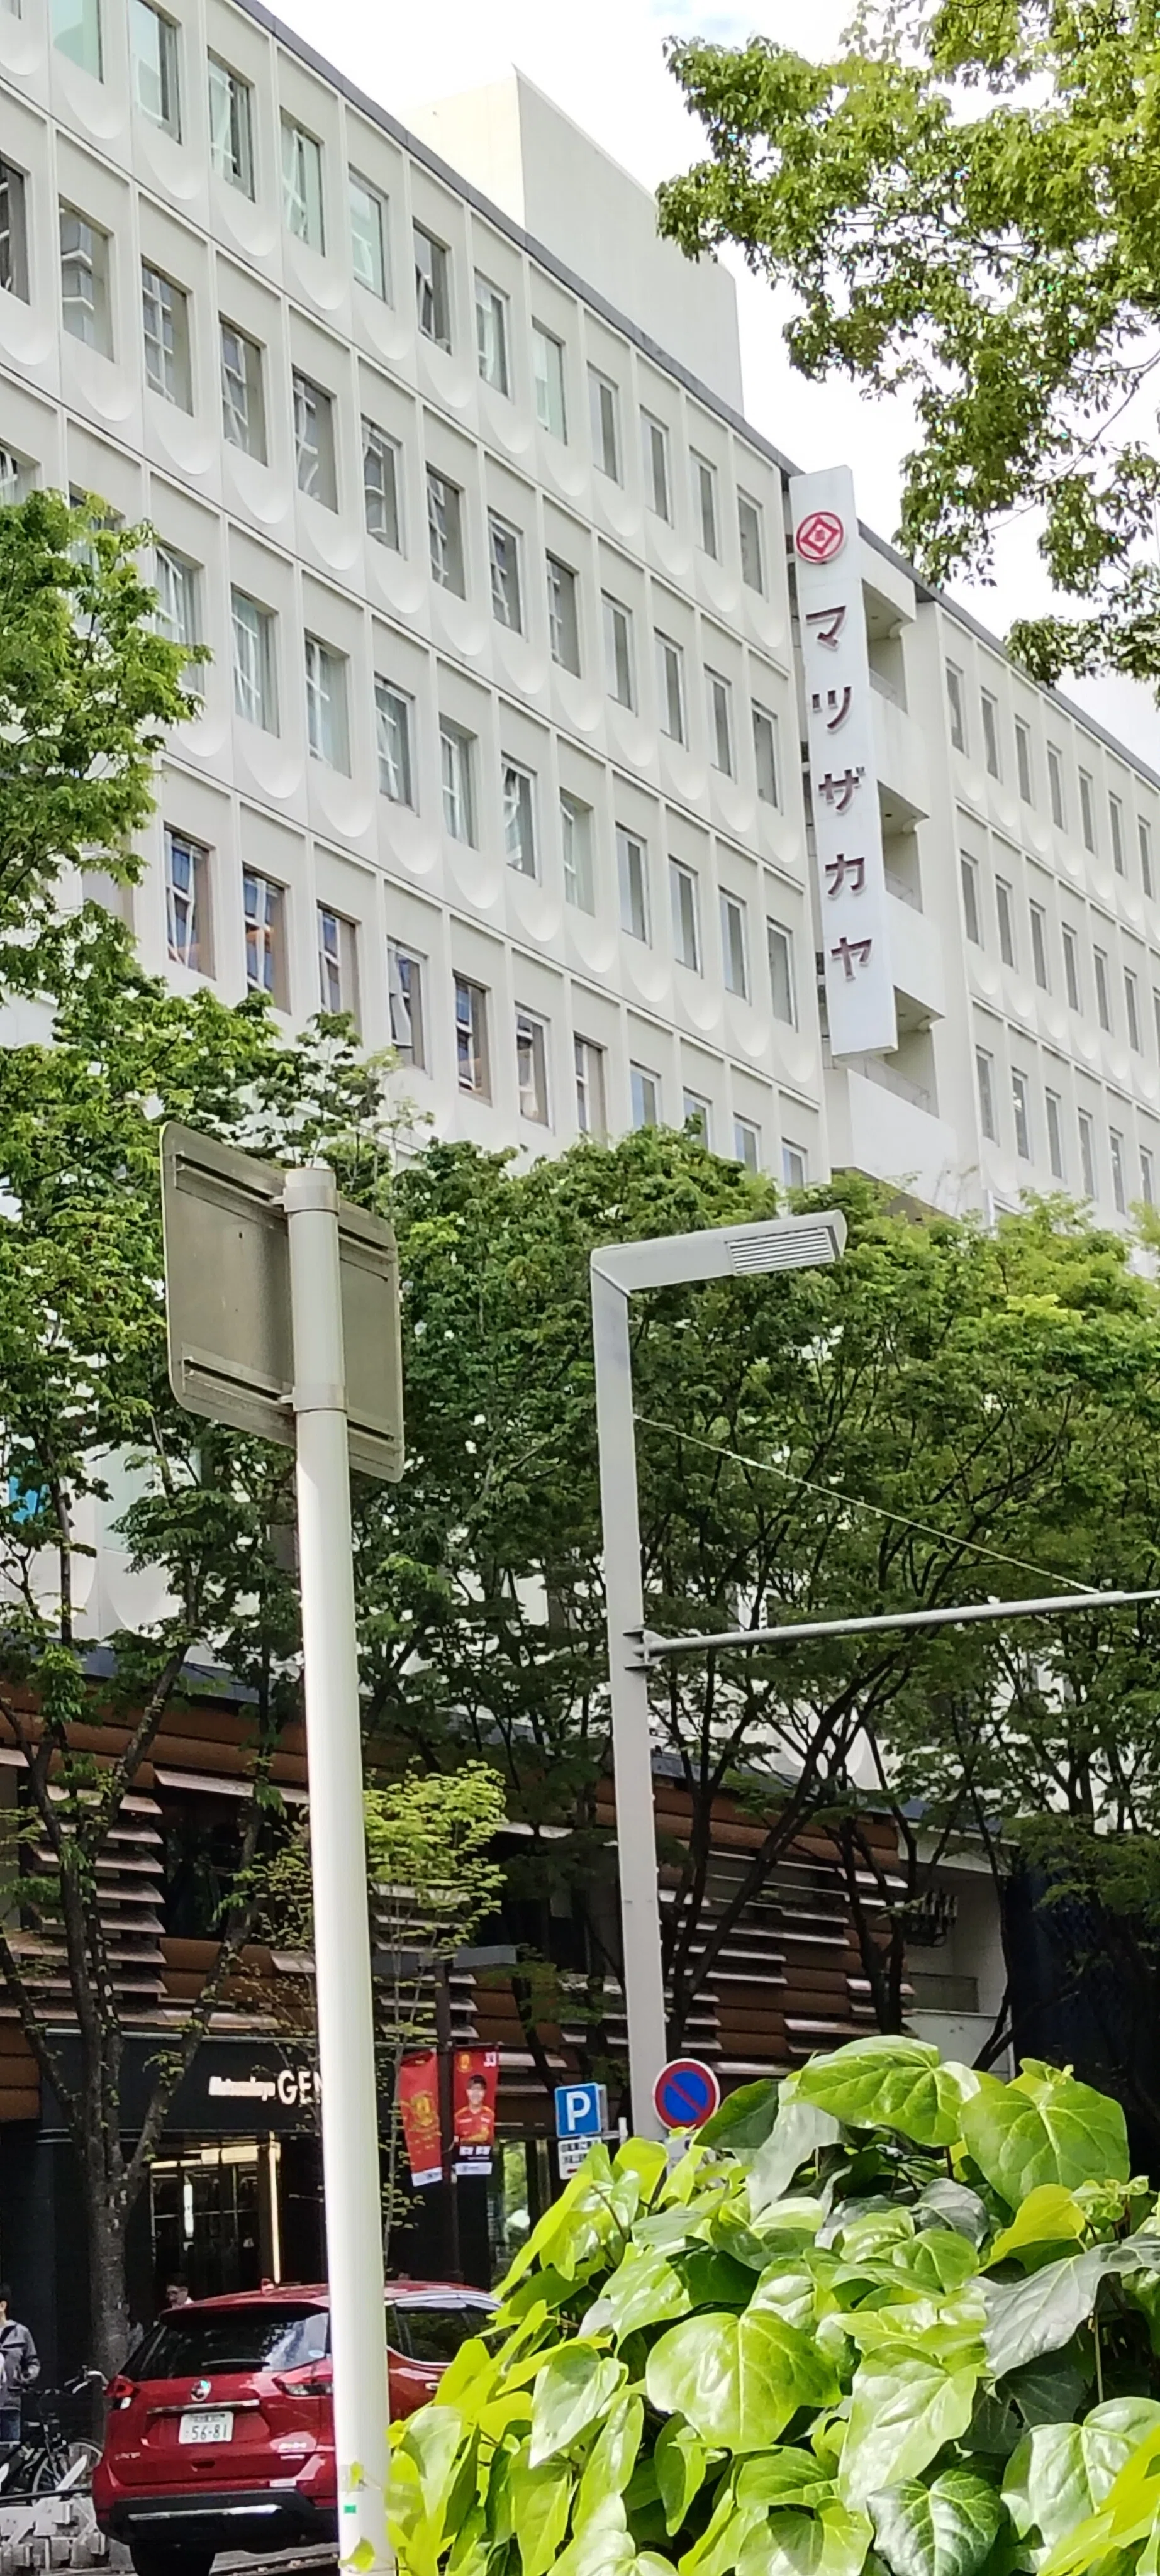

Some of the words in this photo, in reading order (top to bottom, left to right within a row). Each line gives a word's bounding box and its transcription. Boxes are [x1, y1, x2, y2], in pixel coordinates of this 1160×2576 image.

[806, 604, 873, 982] マツザカヤ
[566, 2091, 591, 2131] P
[192, 2424, 227, 2440] 56-81
